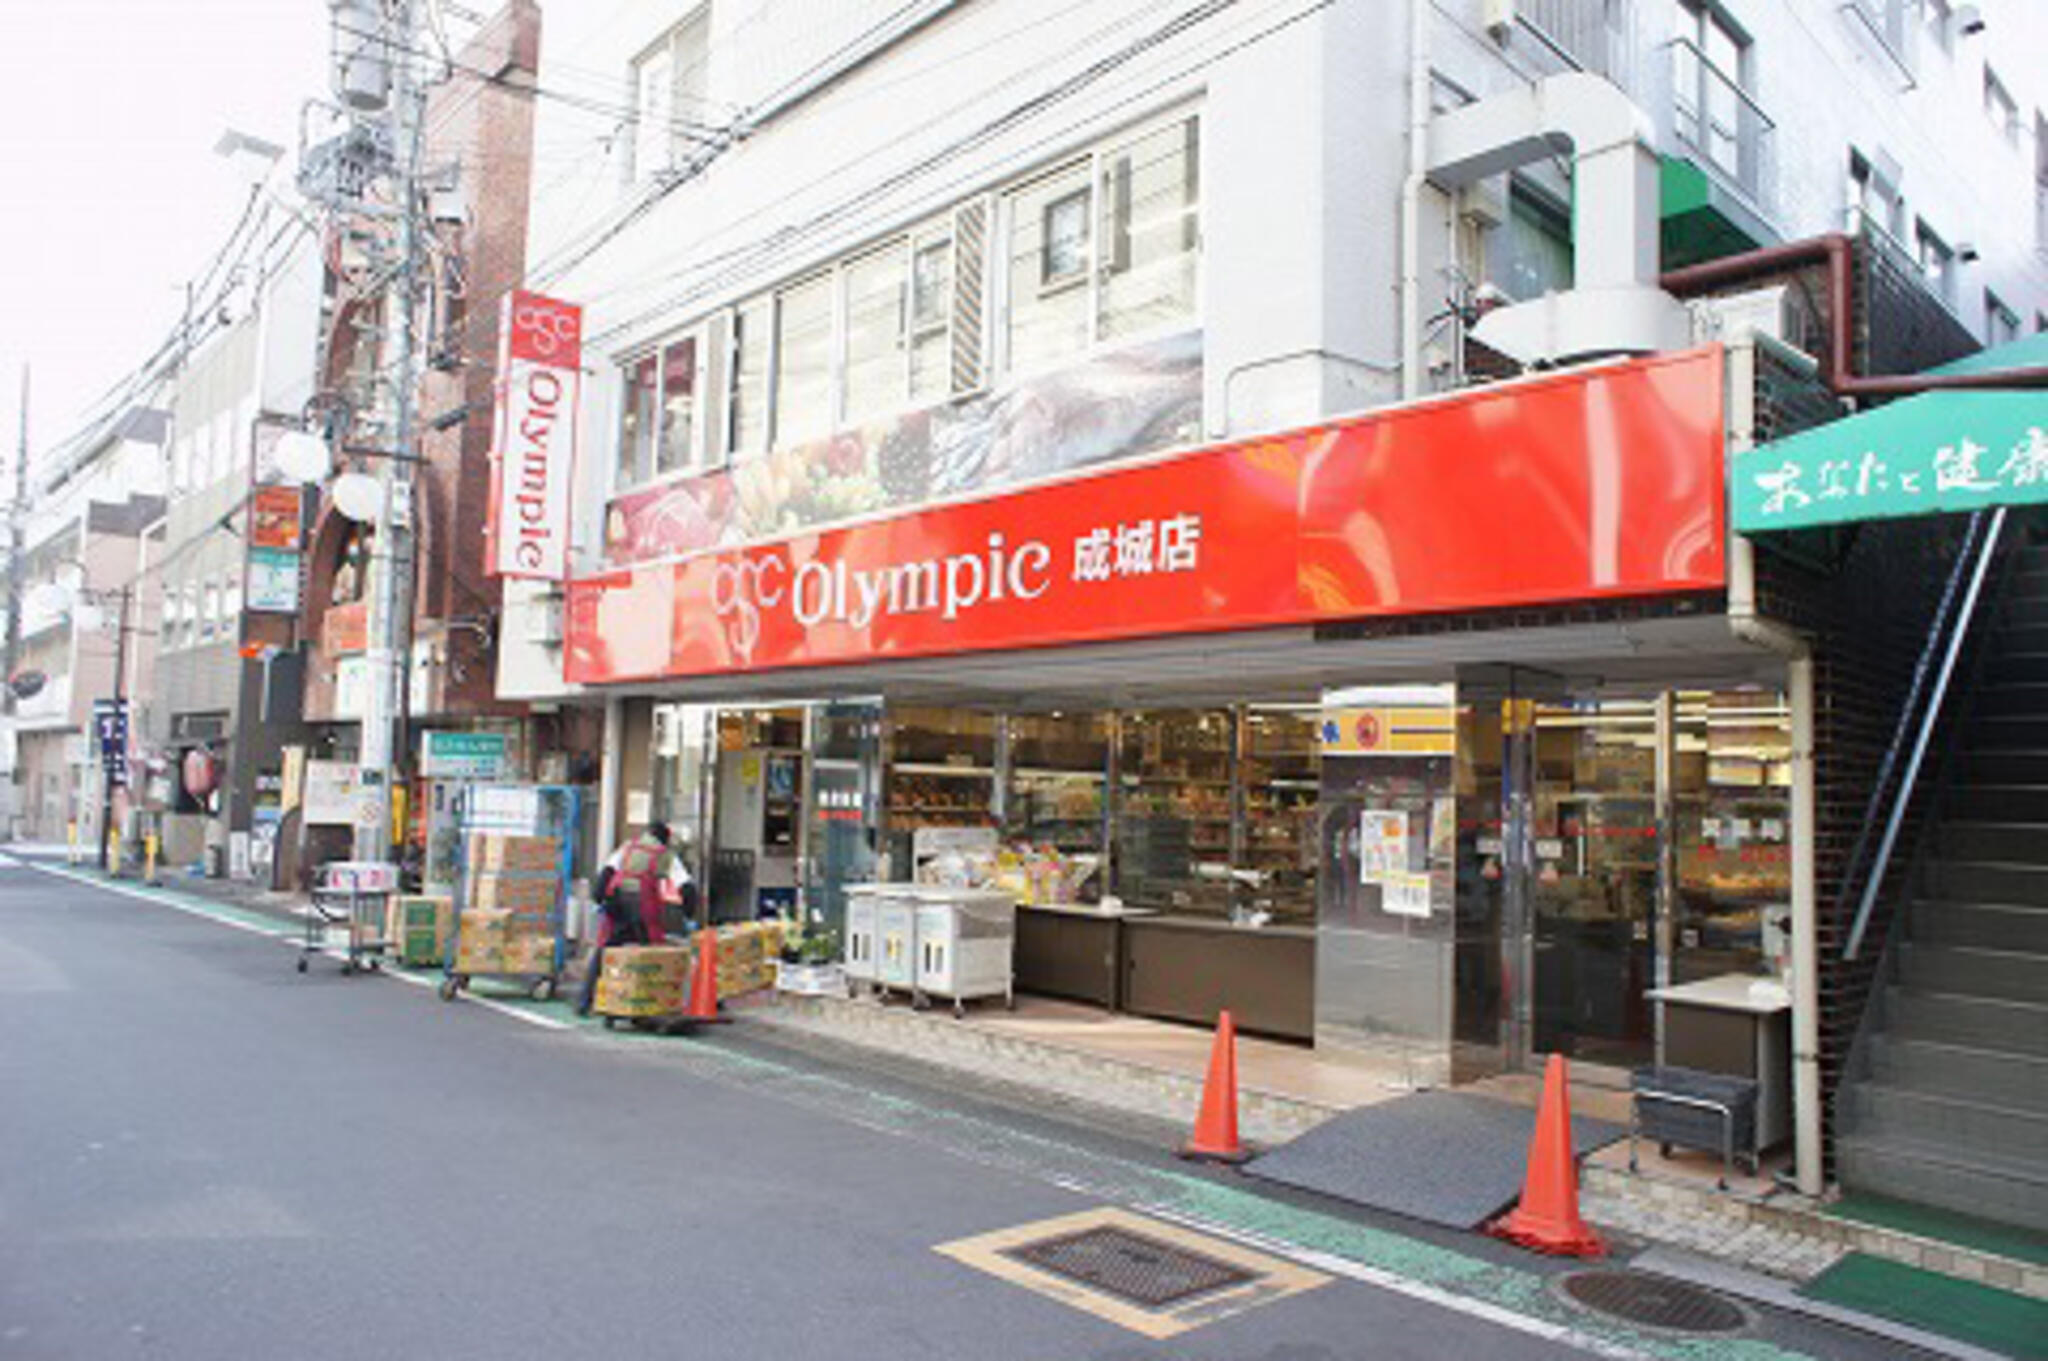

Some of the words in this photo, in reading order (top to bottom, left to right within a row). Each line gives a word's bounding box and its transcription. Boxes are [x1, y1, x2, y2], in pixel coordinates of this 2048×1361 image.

[515, 370, 562, 568] Olympic
[792, 530, 1051, 629] Olympic
[1072, 513, 1200, 582] 成城店
